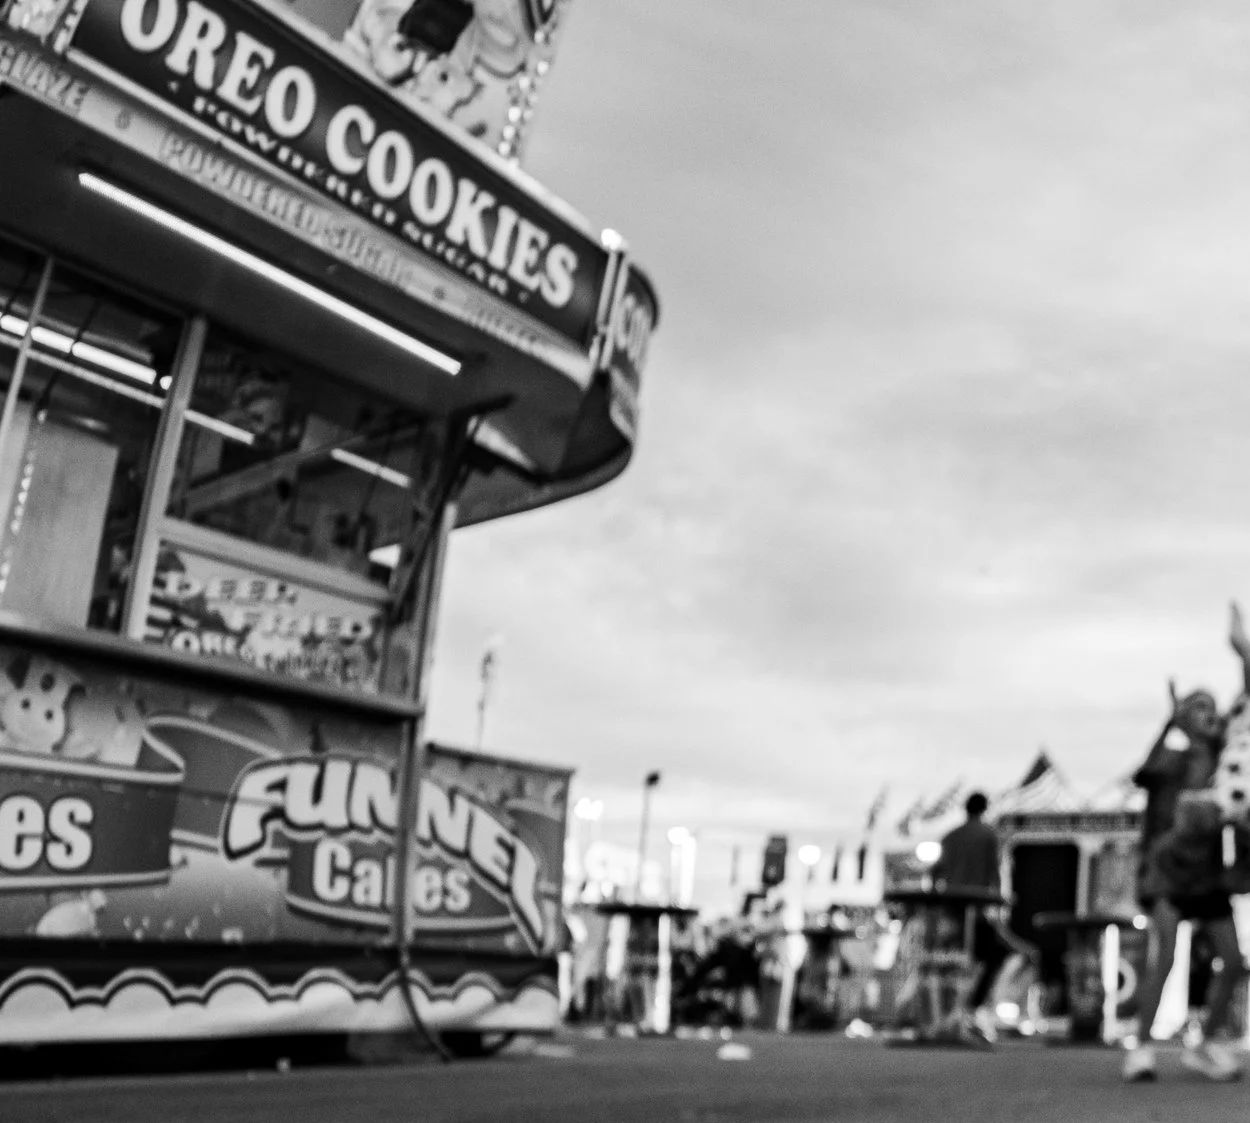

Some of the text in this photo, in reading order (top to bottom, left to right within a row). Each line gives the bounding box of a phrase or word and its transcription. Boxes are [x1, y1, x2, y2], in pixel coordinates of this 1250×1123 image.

[120, 0, 577, 308] OREO COOKIES
[0, 795, 94, 870] es
[227, 758, 543, 948] FUNNEL
